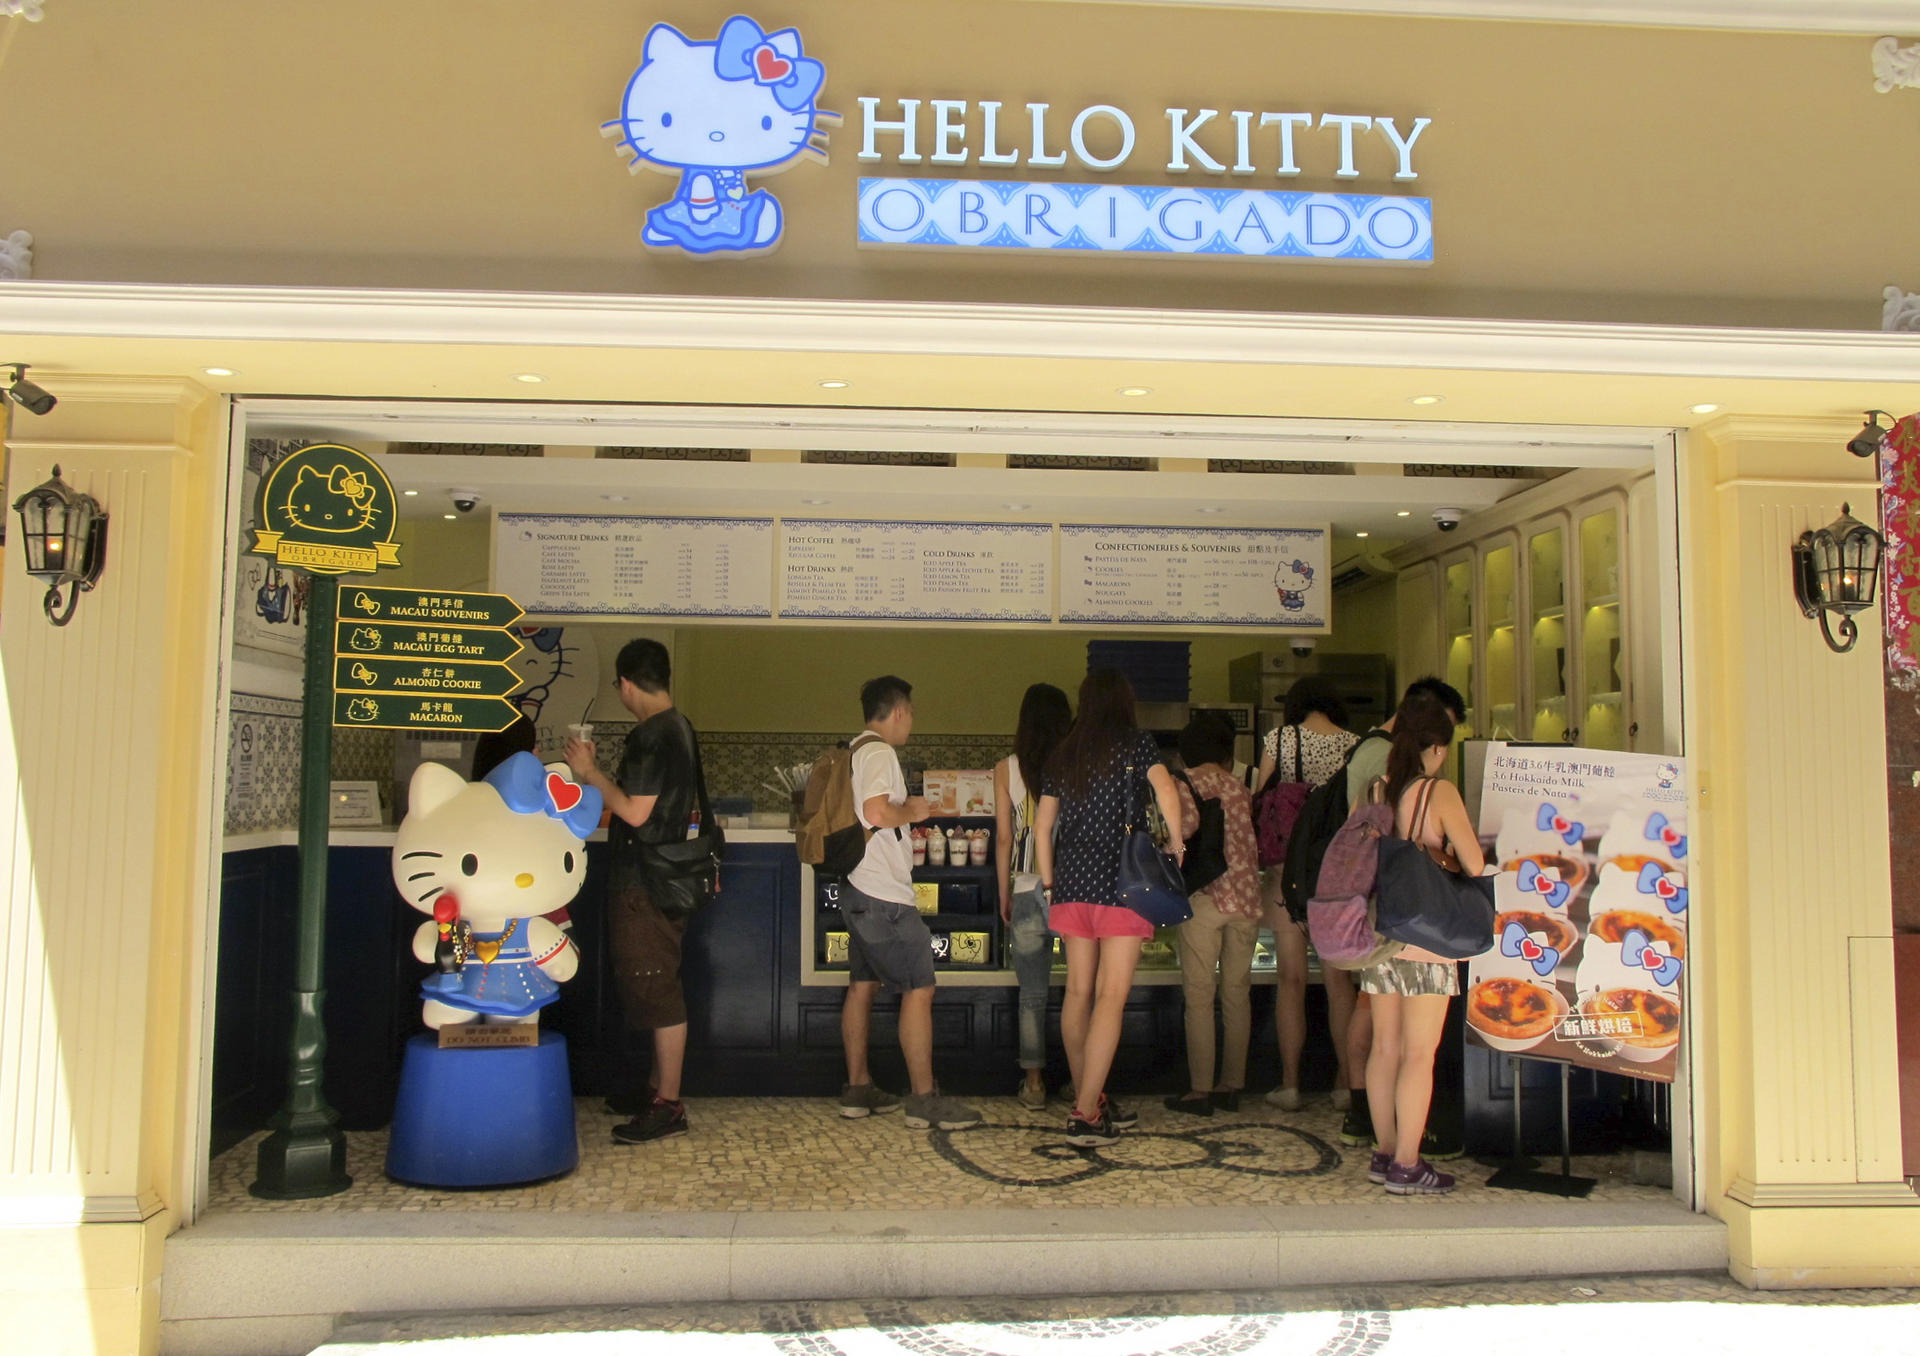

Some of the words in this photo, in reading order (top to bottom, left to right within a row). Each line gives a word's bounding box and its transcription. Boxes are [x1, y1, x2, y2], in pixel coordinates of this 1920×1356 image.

[858, 96, 1135, 170] HELLO
[1166, 108, 1432, 181] KITTY
[872, 187, 1418, 249] OBRIGADO
[580, 534, 609, 542] DRINKS
[788, 536, 805, 544] HOT
[283, 545, 326, 556] HELLO
[333, 550, 373, 561] KITTY
[1094, 542, 1179, 552] CONFECTIONERIES
[1181, 543, 1189, 552] &
[1191, 544, 1241, 553] SOUVENIRS
[923, 550, 944, 558] COLD
[946, 550, 976, 558] DRINKS
[291, 555, 363, 567] OBRIGADO
[807, 565, 836, 573] DRINKS
[418, 596, 464, 609] 澳門手信
[390, 607, 429, 617] MACAU
[431, 608, 490, 620] SOUVENIRS
[393, 642, 432, 652] MACAU
[434, 644, 456, 653] EGG
[457, 645, 485, 655] TART
[393, 677, 440, 687] ALMOND
[442, 679, 482, 689] COOKIE
[421, 702, 453, 713] 馬卡龍
[409, 712, 463, 723] MACARON
[1492, 771, 1507, 780] 3.6
[1509, 770, 1558, 785] Hokkaido
[1561, 776, 1585, 788] Milk
[1492, 782, 1525, 794] Pasteis
[1527, 786, 1539, 796] de
[1542, 788, 1567, 799] Nata
[446, 1036, 464, 1044] DO
[495, 1035, 530, 1043] CLIMB
[1583, 1047, 1616, 1058] Hokkaido
